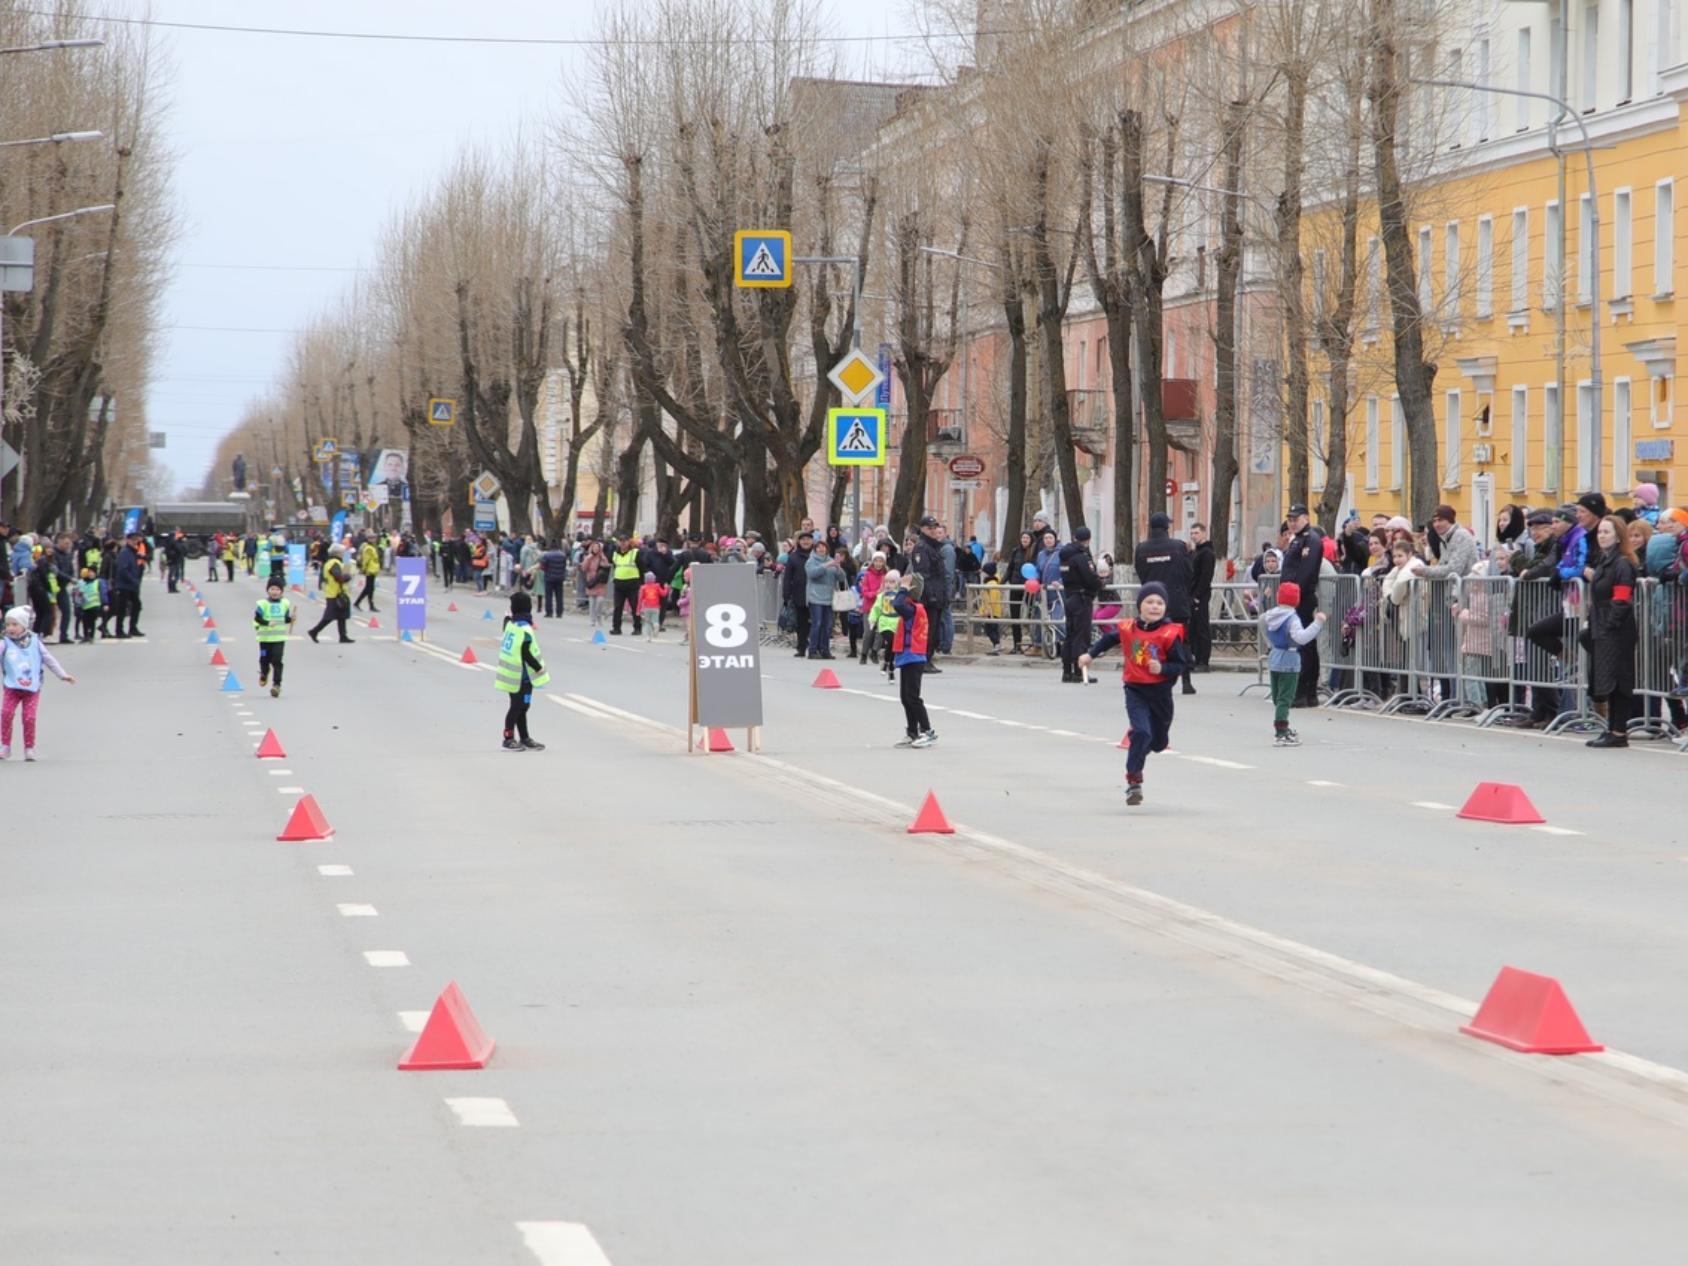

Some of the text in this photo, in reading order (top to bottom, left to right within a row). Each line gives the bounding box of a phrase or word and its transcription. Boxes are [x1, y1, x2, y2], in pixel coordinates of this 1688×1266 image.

[402, 575, 421, 595] 7
[399, 597, 425, 605] ЭТАП
[705, 603, 749, 648] 8
[698, 654, 754, 669] ЭТАП
